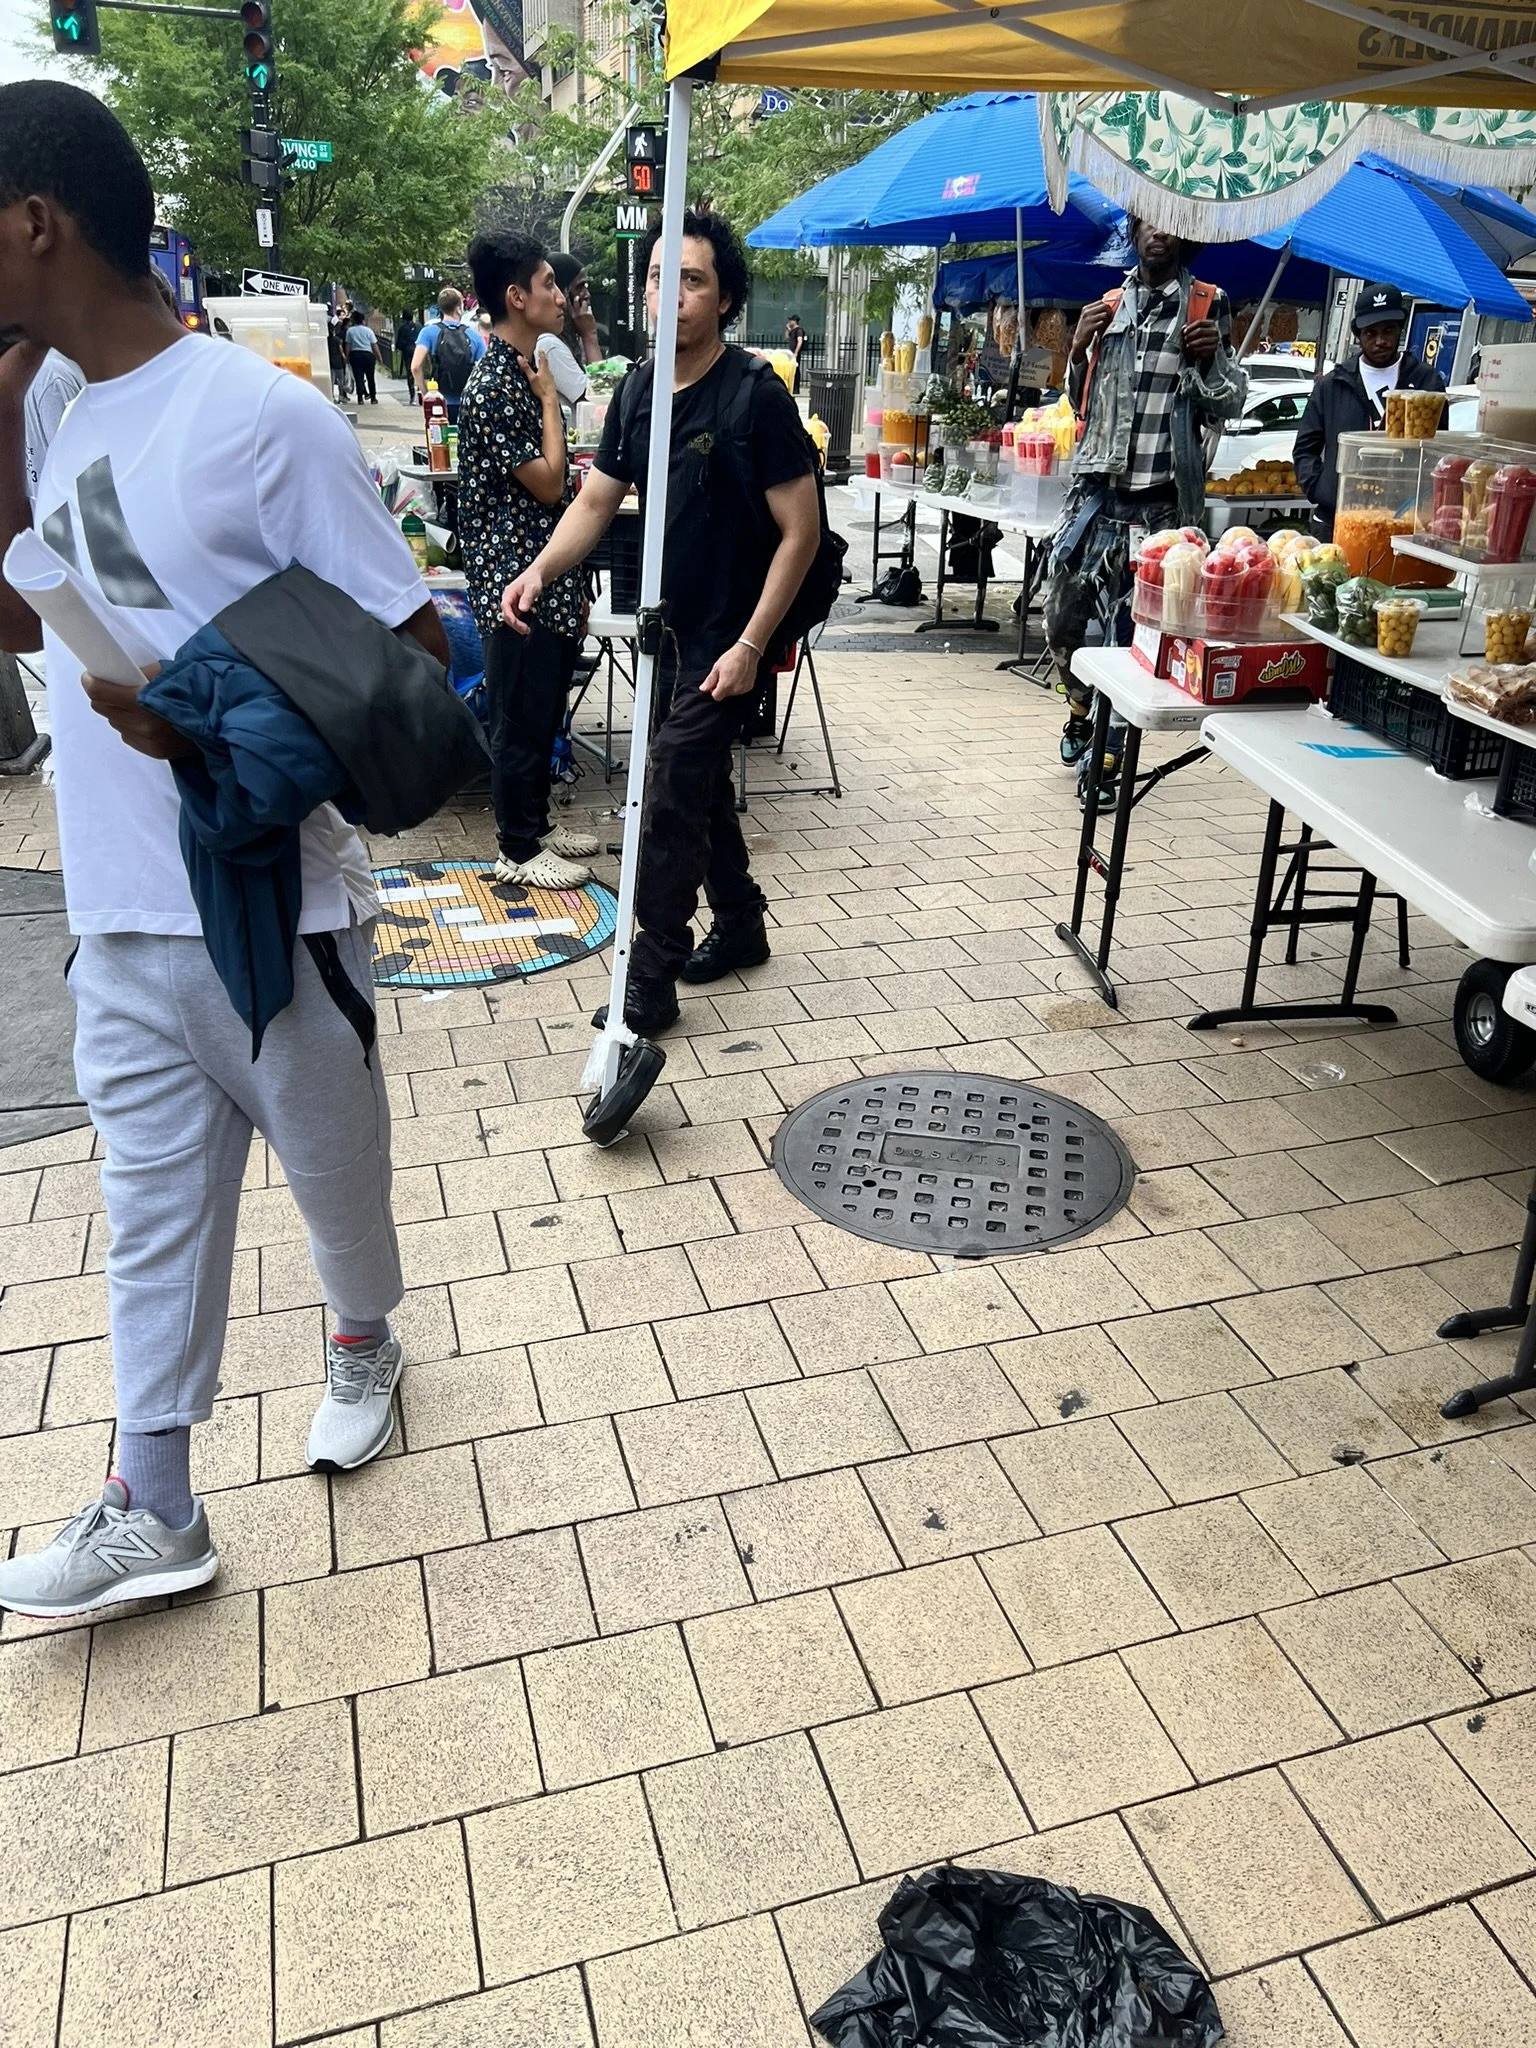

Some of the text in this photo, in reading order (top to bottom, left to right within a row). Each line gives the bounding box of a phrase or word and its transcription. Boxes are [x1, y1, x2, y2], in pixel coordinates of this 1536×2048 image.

[633, 165, 651, 191] 50
[263, 279, 302, 295] ONE WAY
